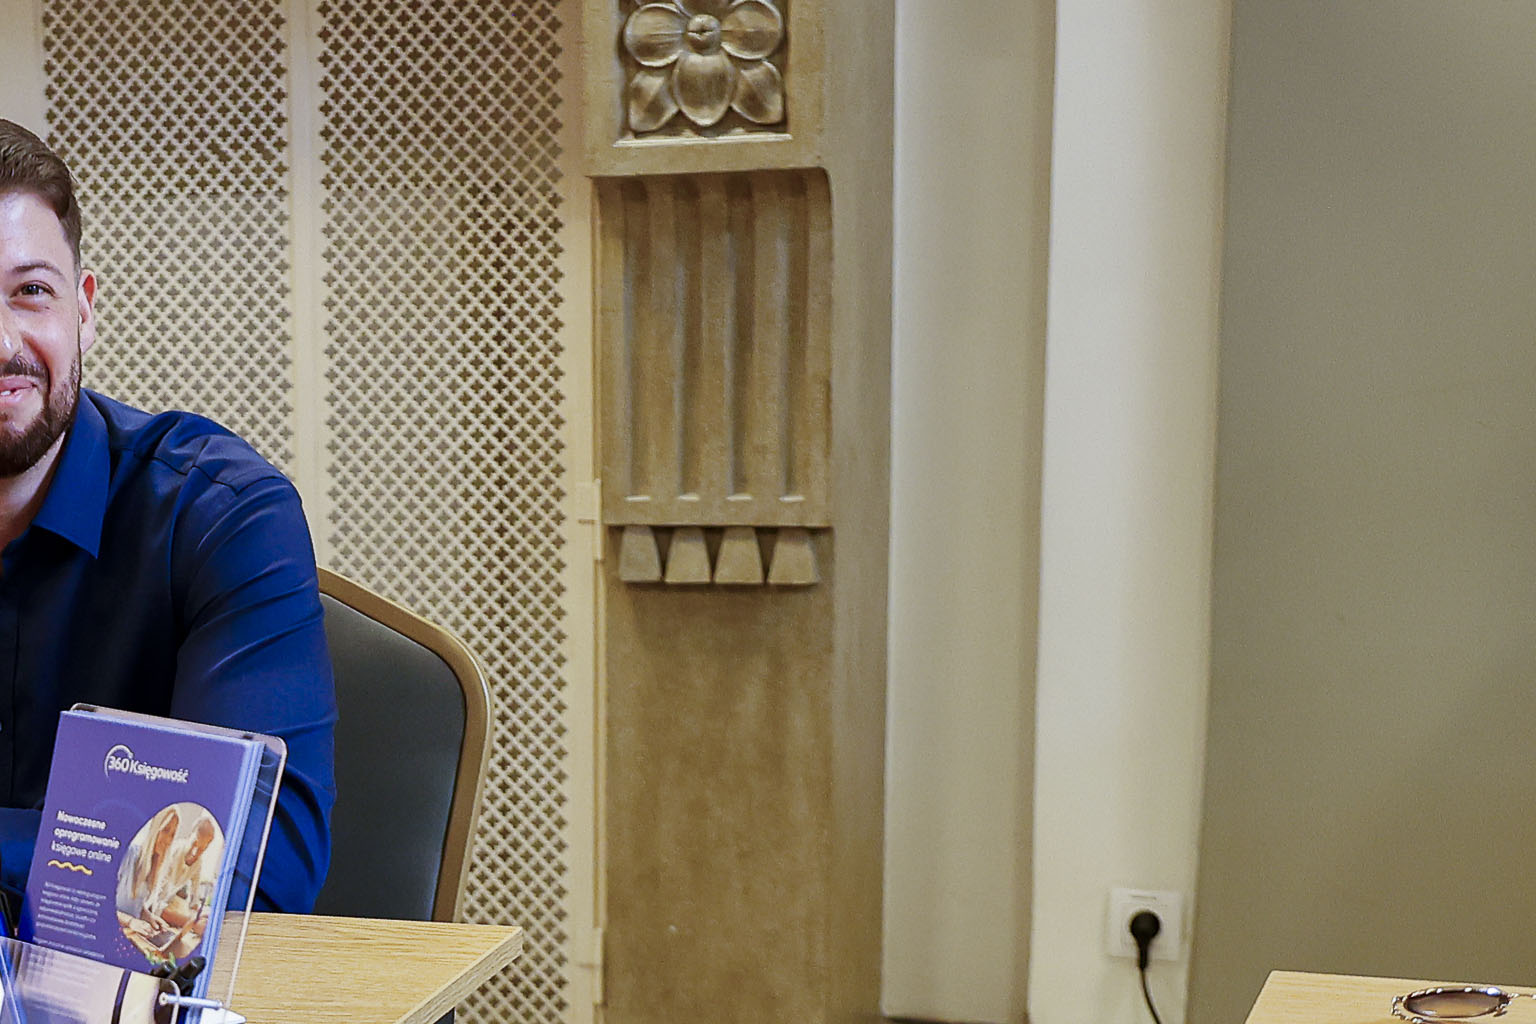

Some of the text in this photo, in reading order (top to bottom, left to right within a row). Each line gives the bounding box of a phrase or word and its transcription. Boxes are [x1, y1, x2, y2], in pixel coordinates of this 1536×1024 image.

[108, 756, 189, 783] 360 Księgowość
[57, 810, 107, 830] Nowoczesne
[54, 827, 121, 849] oprogramowanie
[88, 850, 113, 863] online
